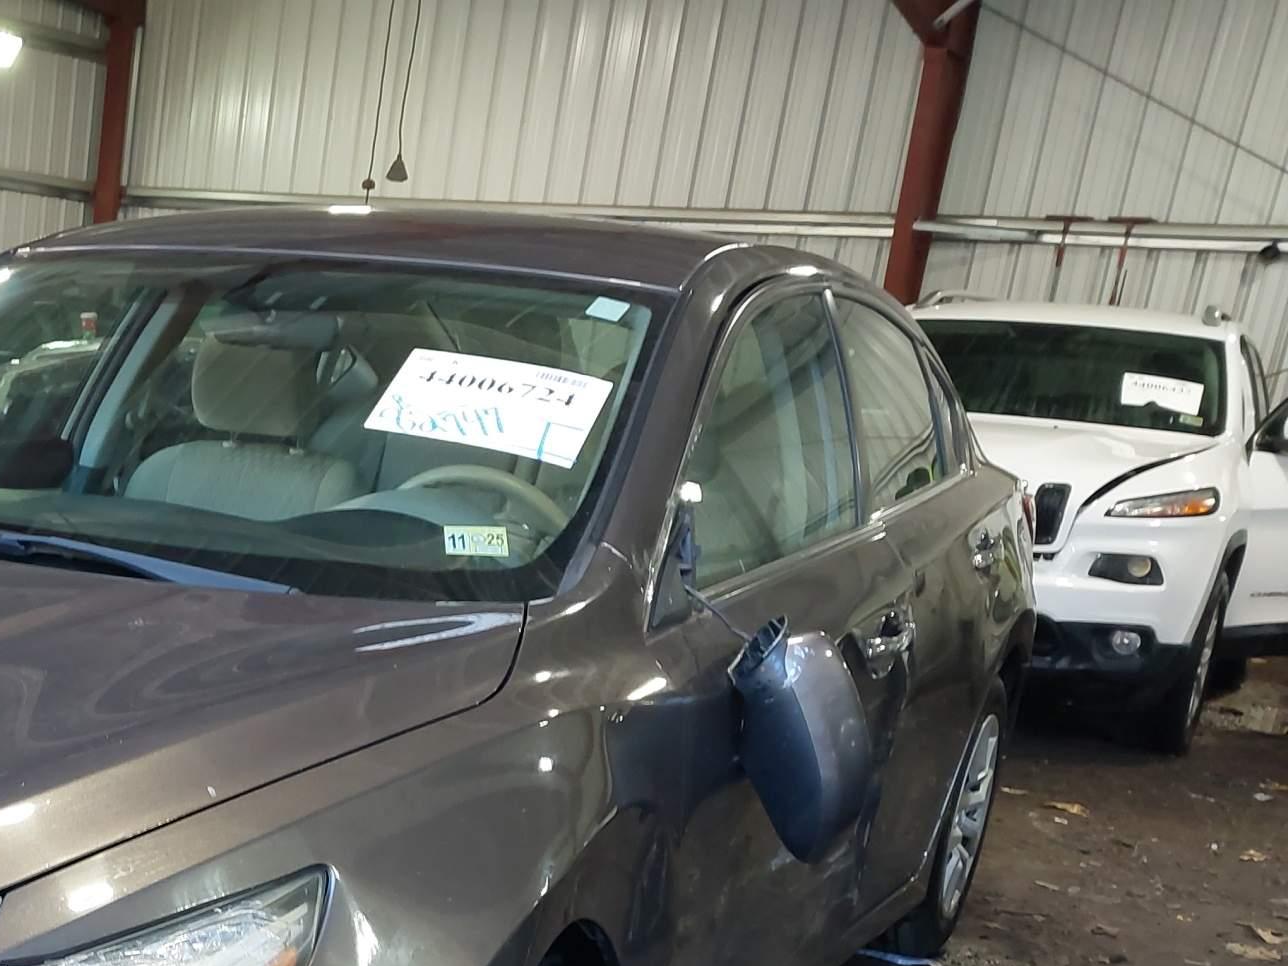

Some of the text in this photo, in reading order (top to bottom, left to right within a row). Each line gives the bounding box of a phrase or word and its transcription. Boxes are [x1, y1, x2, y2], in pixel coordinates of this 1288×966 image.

[418, 369, 577, 407] 44006724
[447, 532, 505, 551] 11 25
